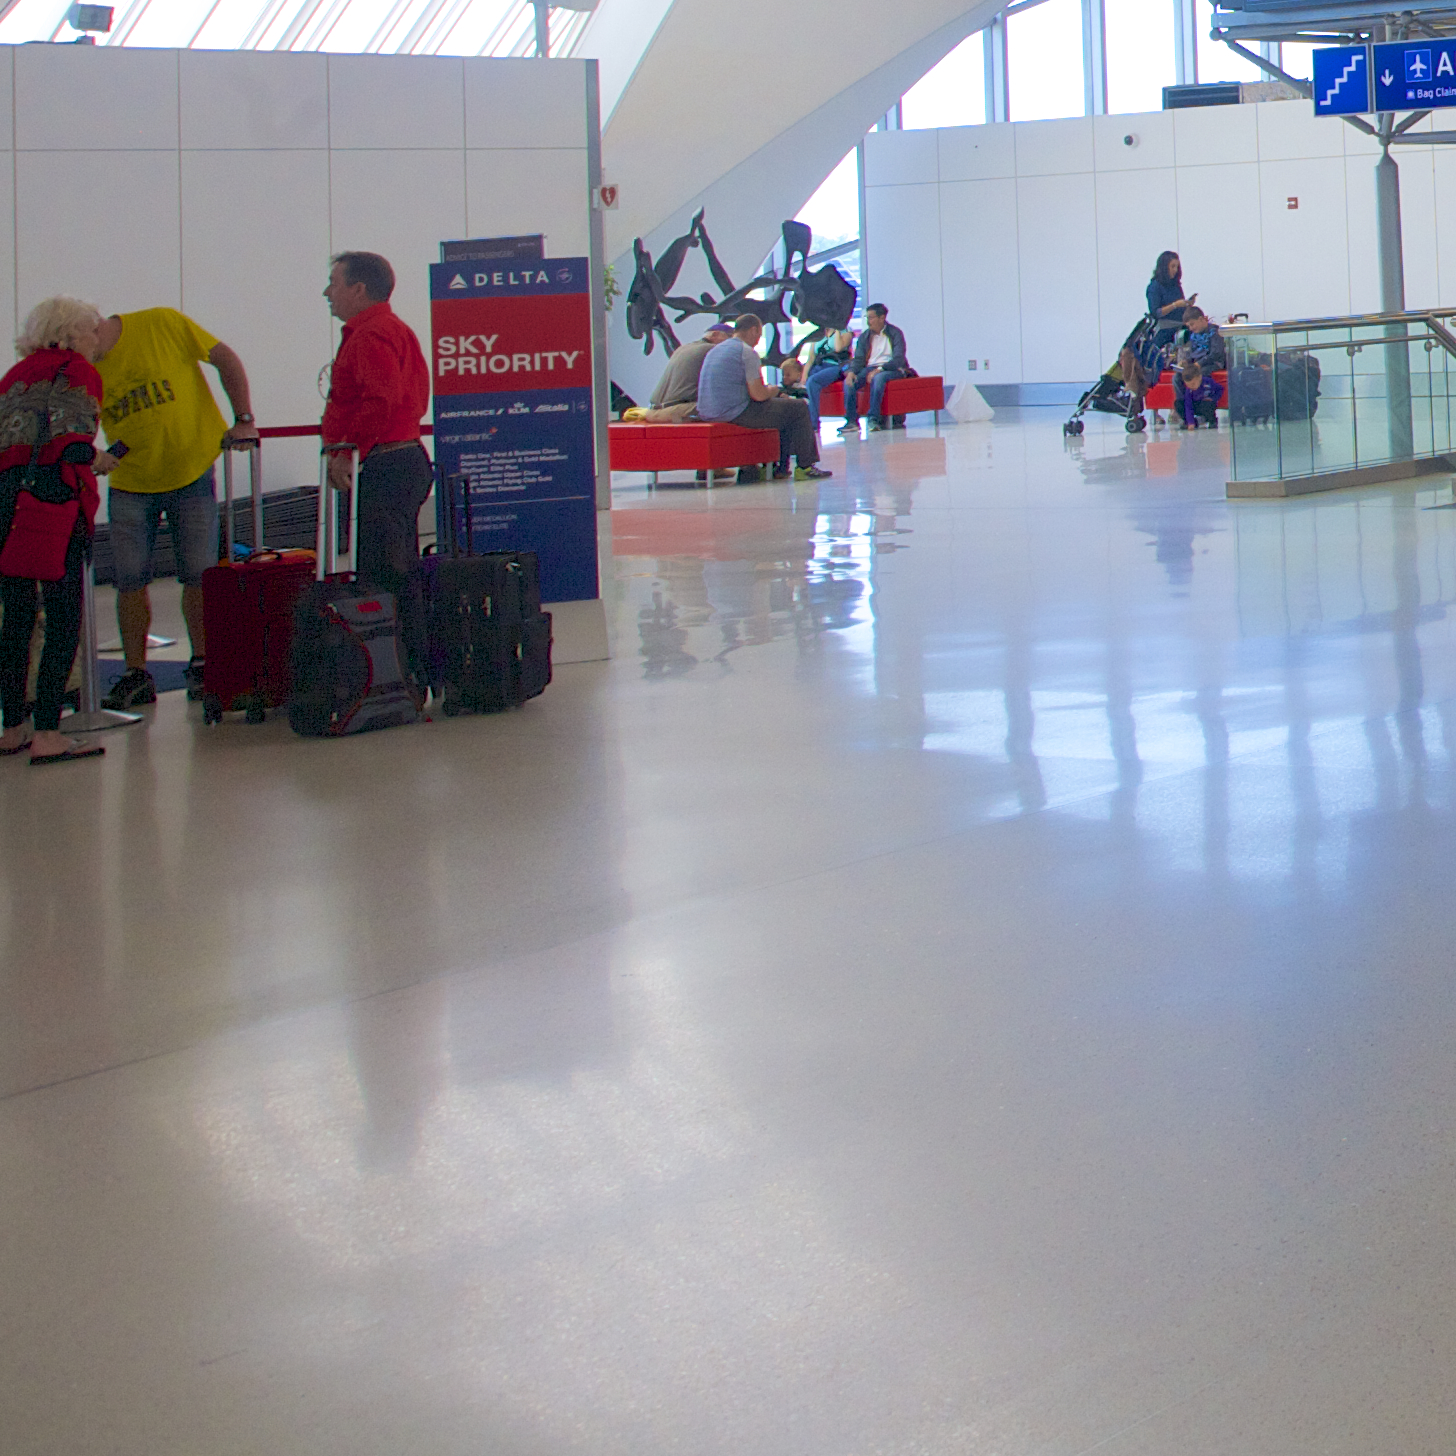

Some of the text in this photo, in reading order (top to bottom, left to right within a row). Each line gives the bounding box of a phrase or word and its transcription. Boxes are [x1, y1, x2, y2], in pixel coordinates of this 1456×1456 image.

[1417, 89, 1433, 99] Bag
[474, 271, 549, 286] DELTA
[438, 334, 499, 355] SKY
[438, 351, 578, 376] PRIORITY
